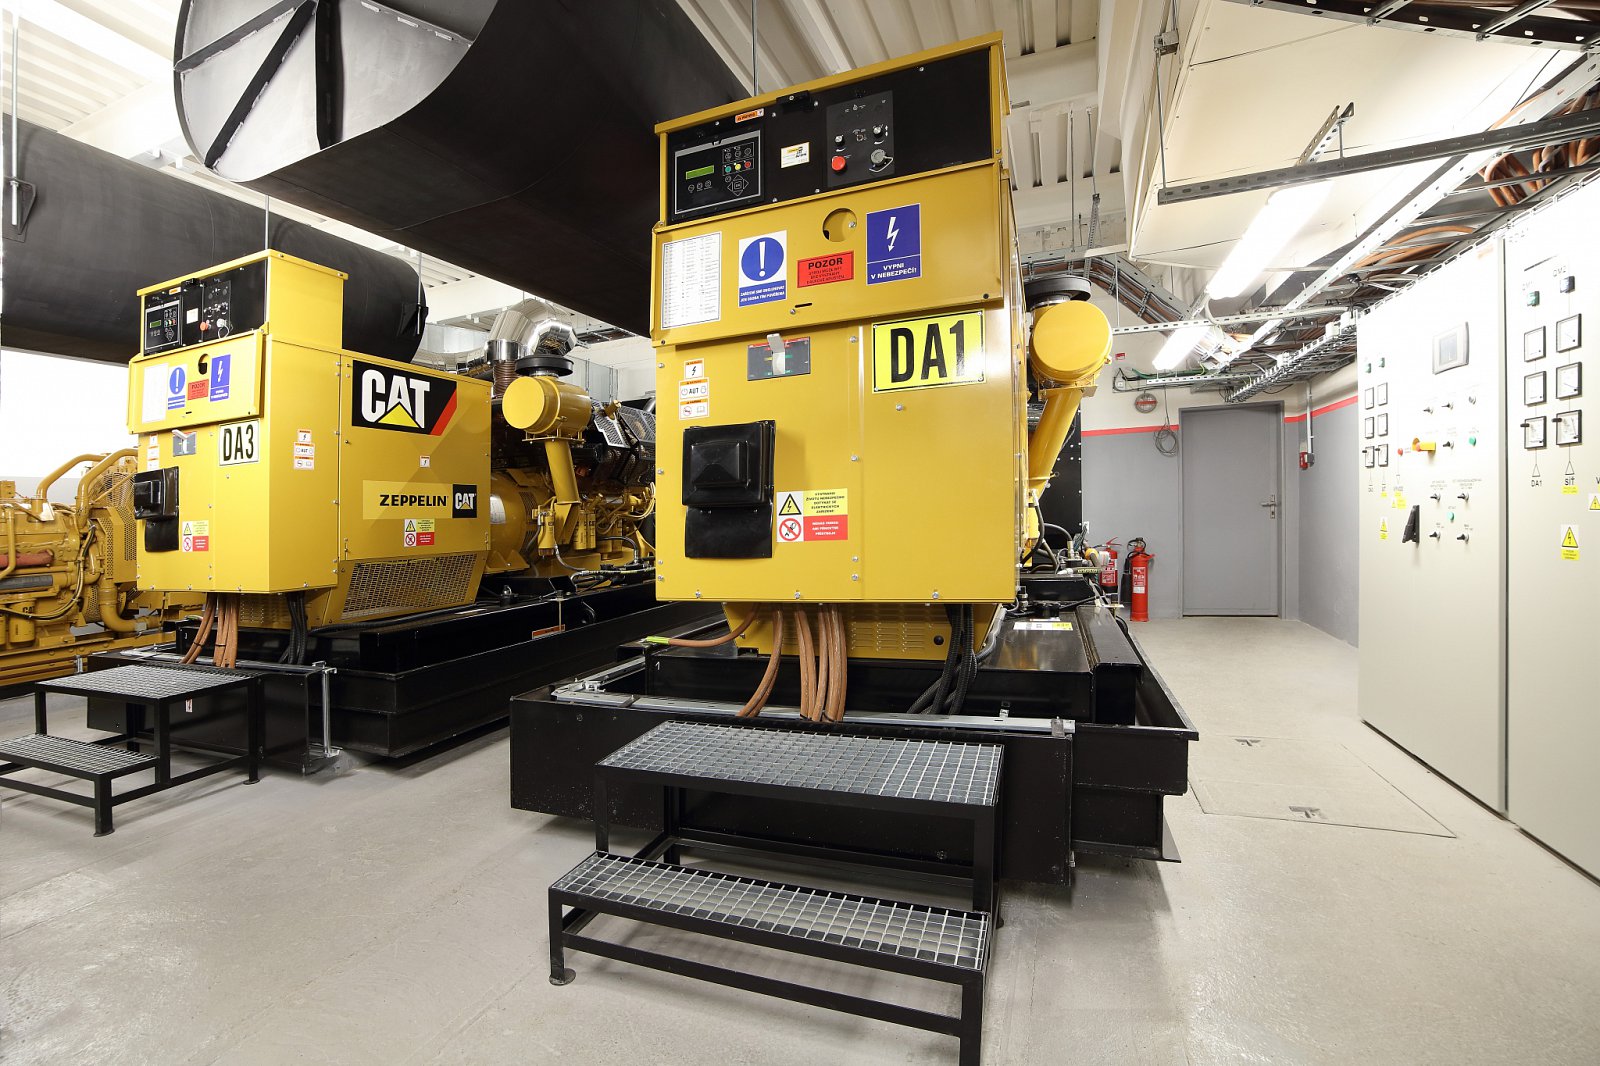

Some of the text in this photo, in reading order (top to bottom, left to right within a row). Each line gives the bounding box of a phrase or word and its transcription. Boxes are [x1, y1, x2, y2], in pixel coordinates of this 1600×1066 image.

[808, 257, 843, 269] POZOR
[883, 262, 905, 271] VYPNI
[890, 319, 965, 384] DA1
[688, 387, 699, 395] AUT
[361, 369, 431, 429] CAT
[223, 424, 254, 461] DA3
[1531, 479, 1542, 487] DA1
[379, 494, 447, 507] ZEPPELIN
[455, 492, 475, 510] CAT
[655, 661, 660, 671] 1
